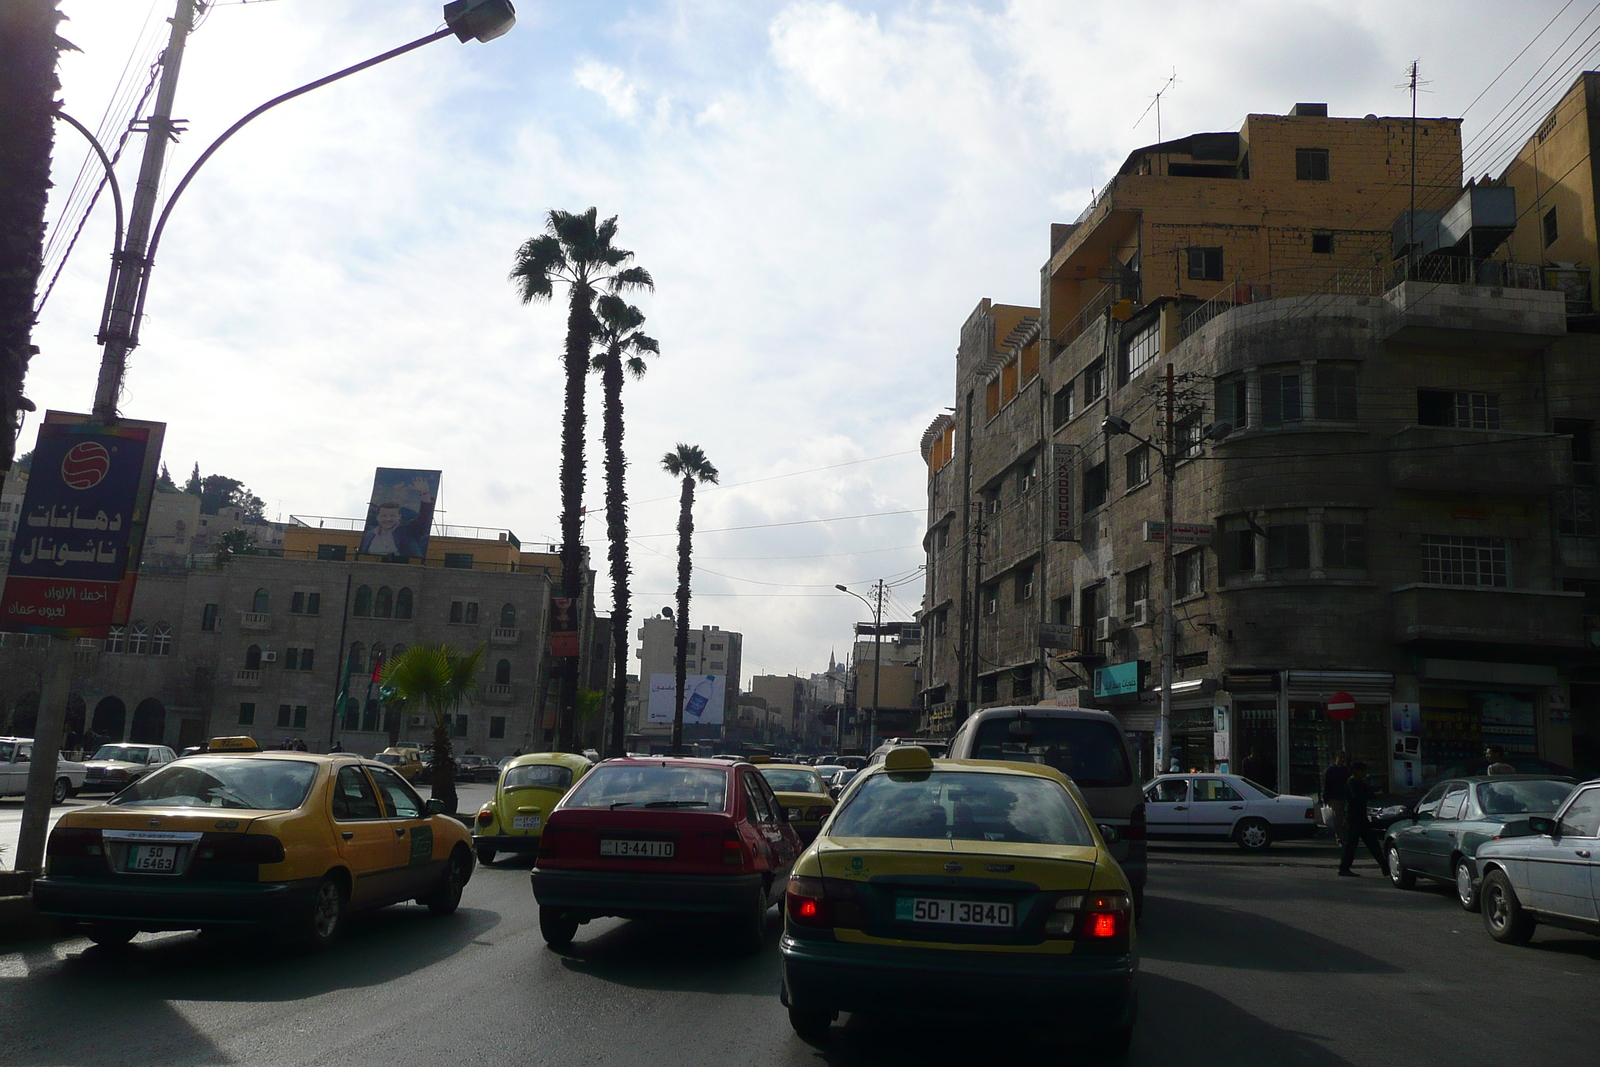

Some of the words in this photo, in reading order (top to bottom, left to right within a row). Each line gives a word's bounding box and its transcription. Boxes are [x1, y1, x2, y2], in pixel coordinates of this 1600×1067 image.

[1058, 463, 1069, 527] KADDOURA
[27, 505, 122, 531] دهانات
[20, 536, 117, 566] ناشونال
[80, 585, 108, 604] أجمل
[8, 602, 36, 615] عمان
[148, 847, 163, 858] 50
[137, 858, 172, 869] 15463
